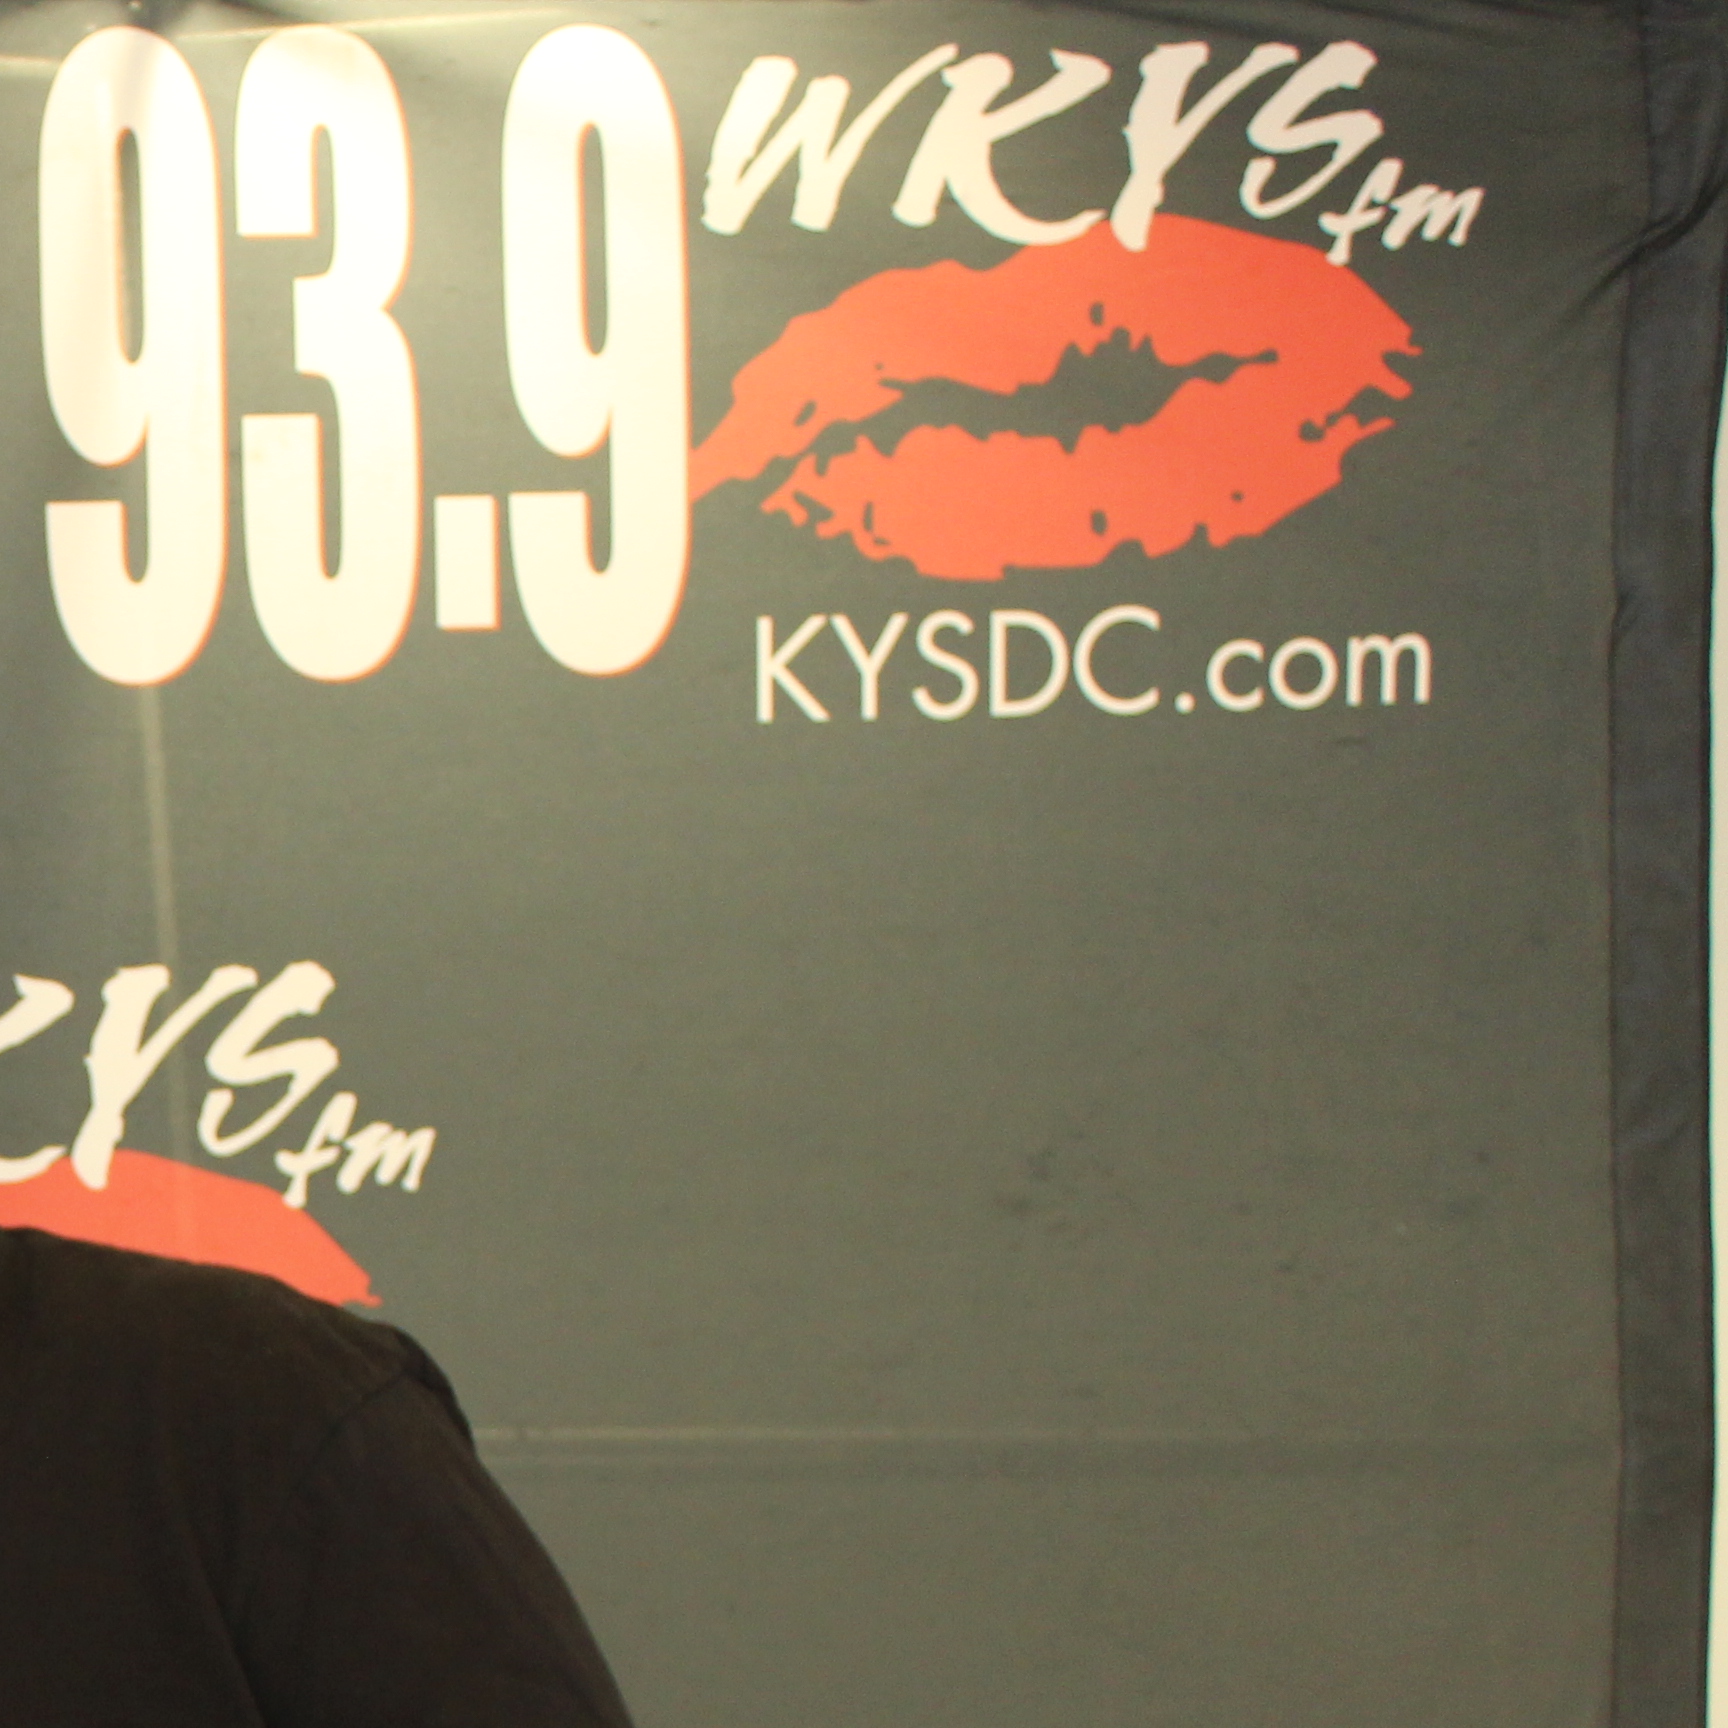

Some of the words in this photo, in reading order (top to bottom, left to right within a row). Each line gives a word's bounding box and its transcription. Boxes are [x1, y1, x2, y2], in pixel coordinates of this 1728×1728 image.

[699, 41, 1383, 250] WKYS
[1319, 160, 1482, 265] fm
[40, 9, 685, 682] 93.9
[756, 607, 1428, 723] KYSDC.com
[276, 1094, 434, 1208] fm
